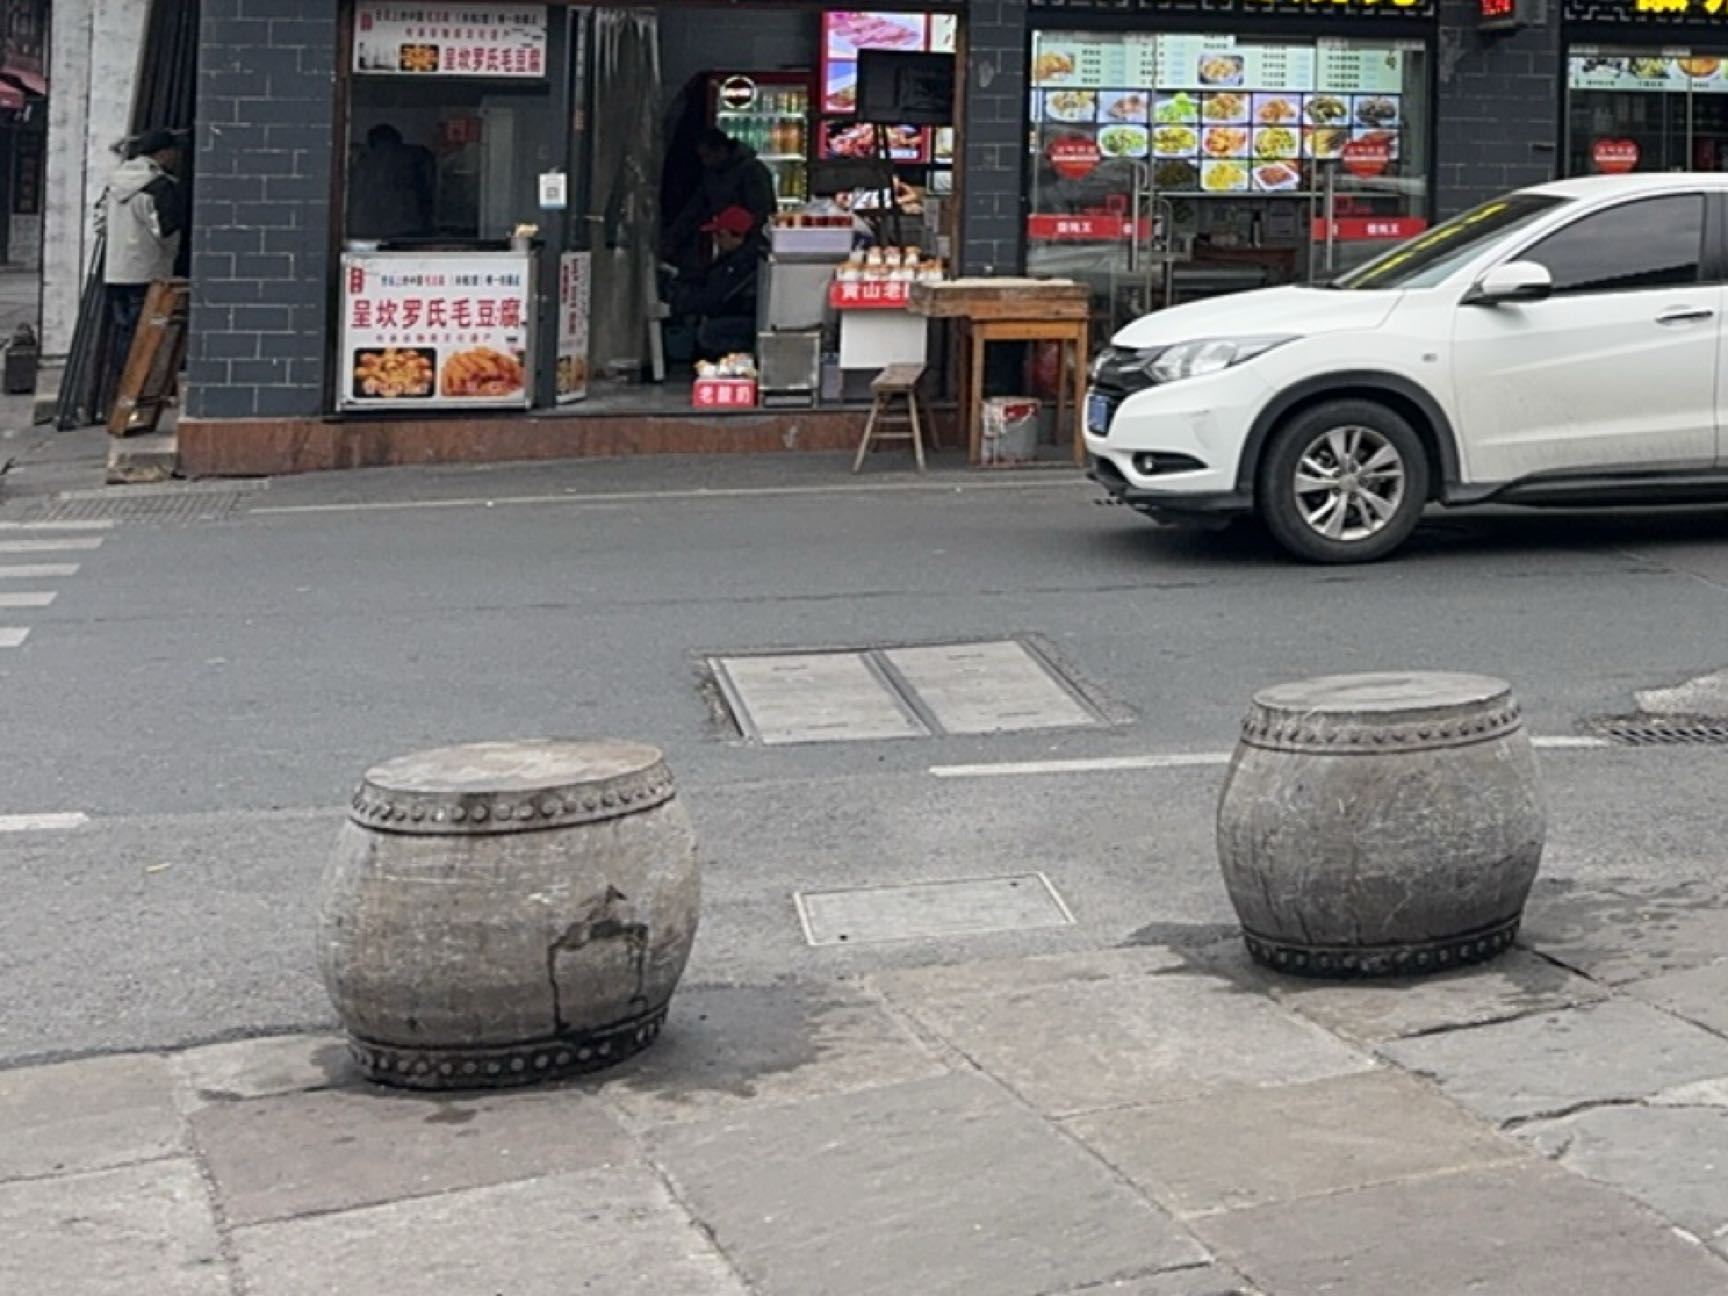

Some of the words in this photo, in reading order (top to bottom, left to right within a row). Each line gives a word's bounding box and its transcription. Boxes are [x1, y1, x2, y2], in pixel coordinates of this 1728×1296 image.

[842, 279, 910, 301] 黄山老
[351, 298, 522, 330] 呈坎罗氏毛豆腐
